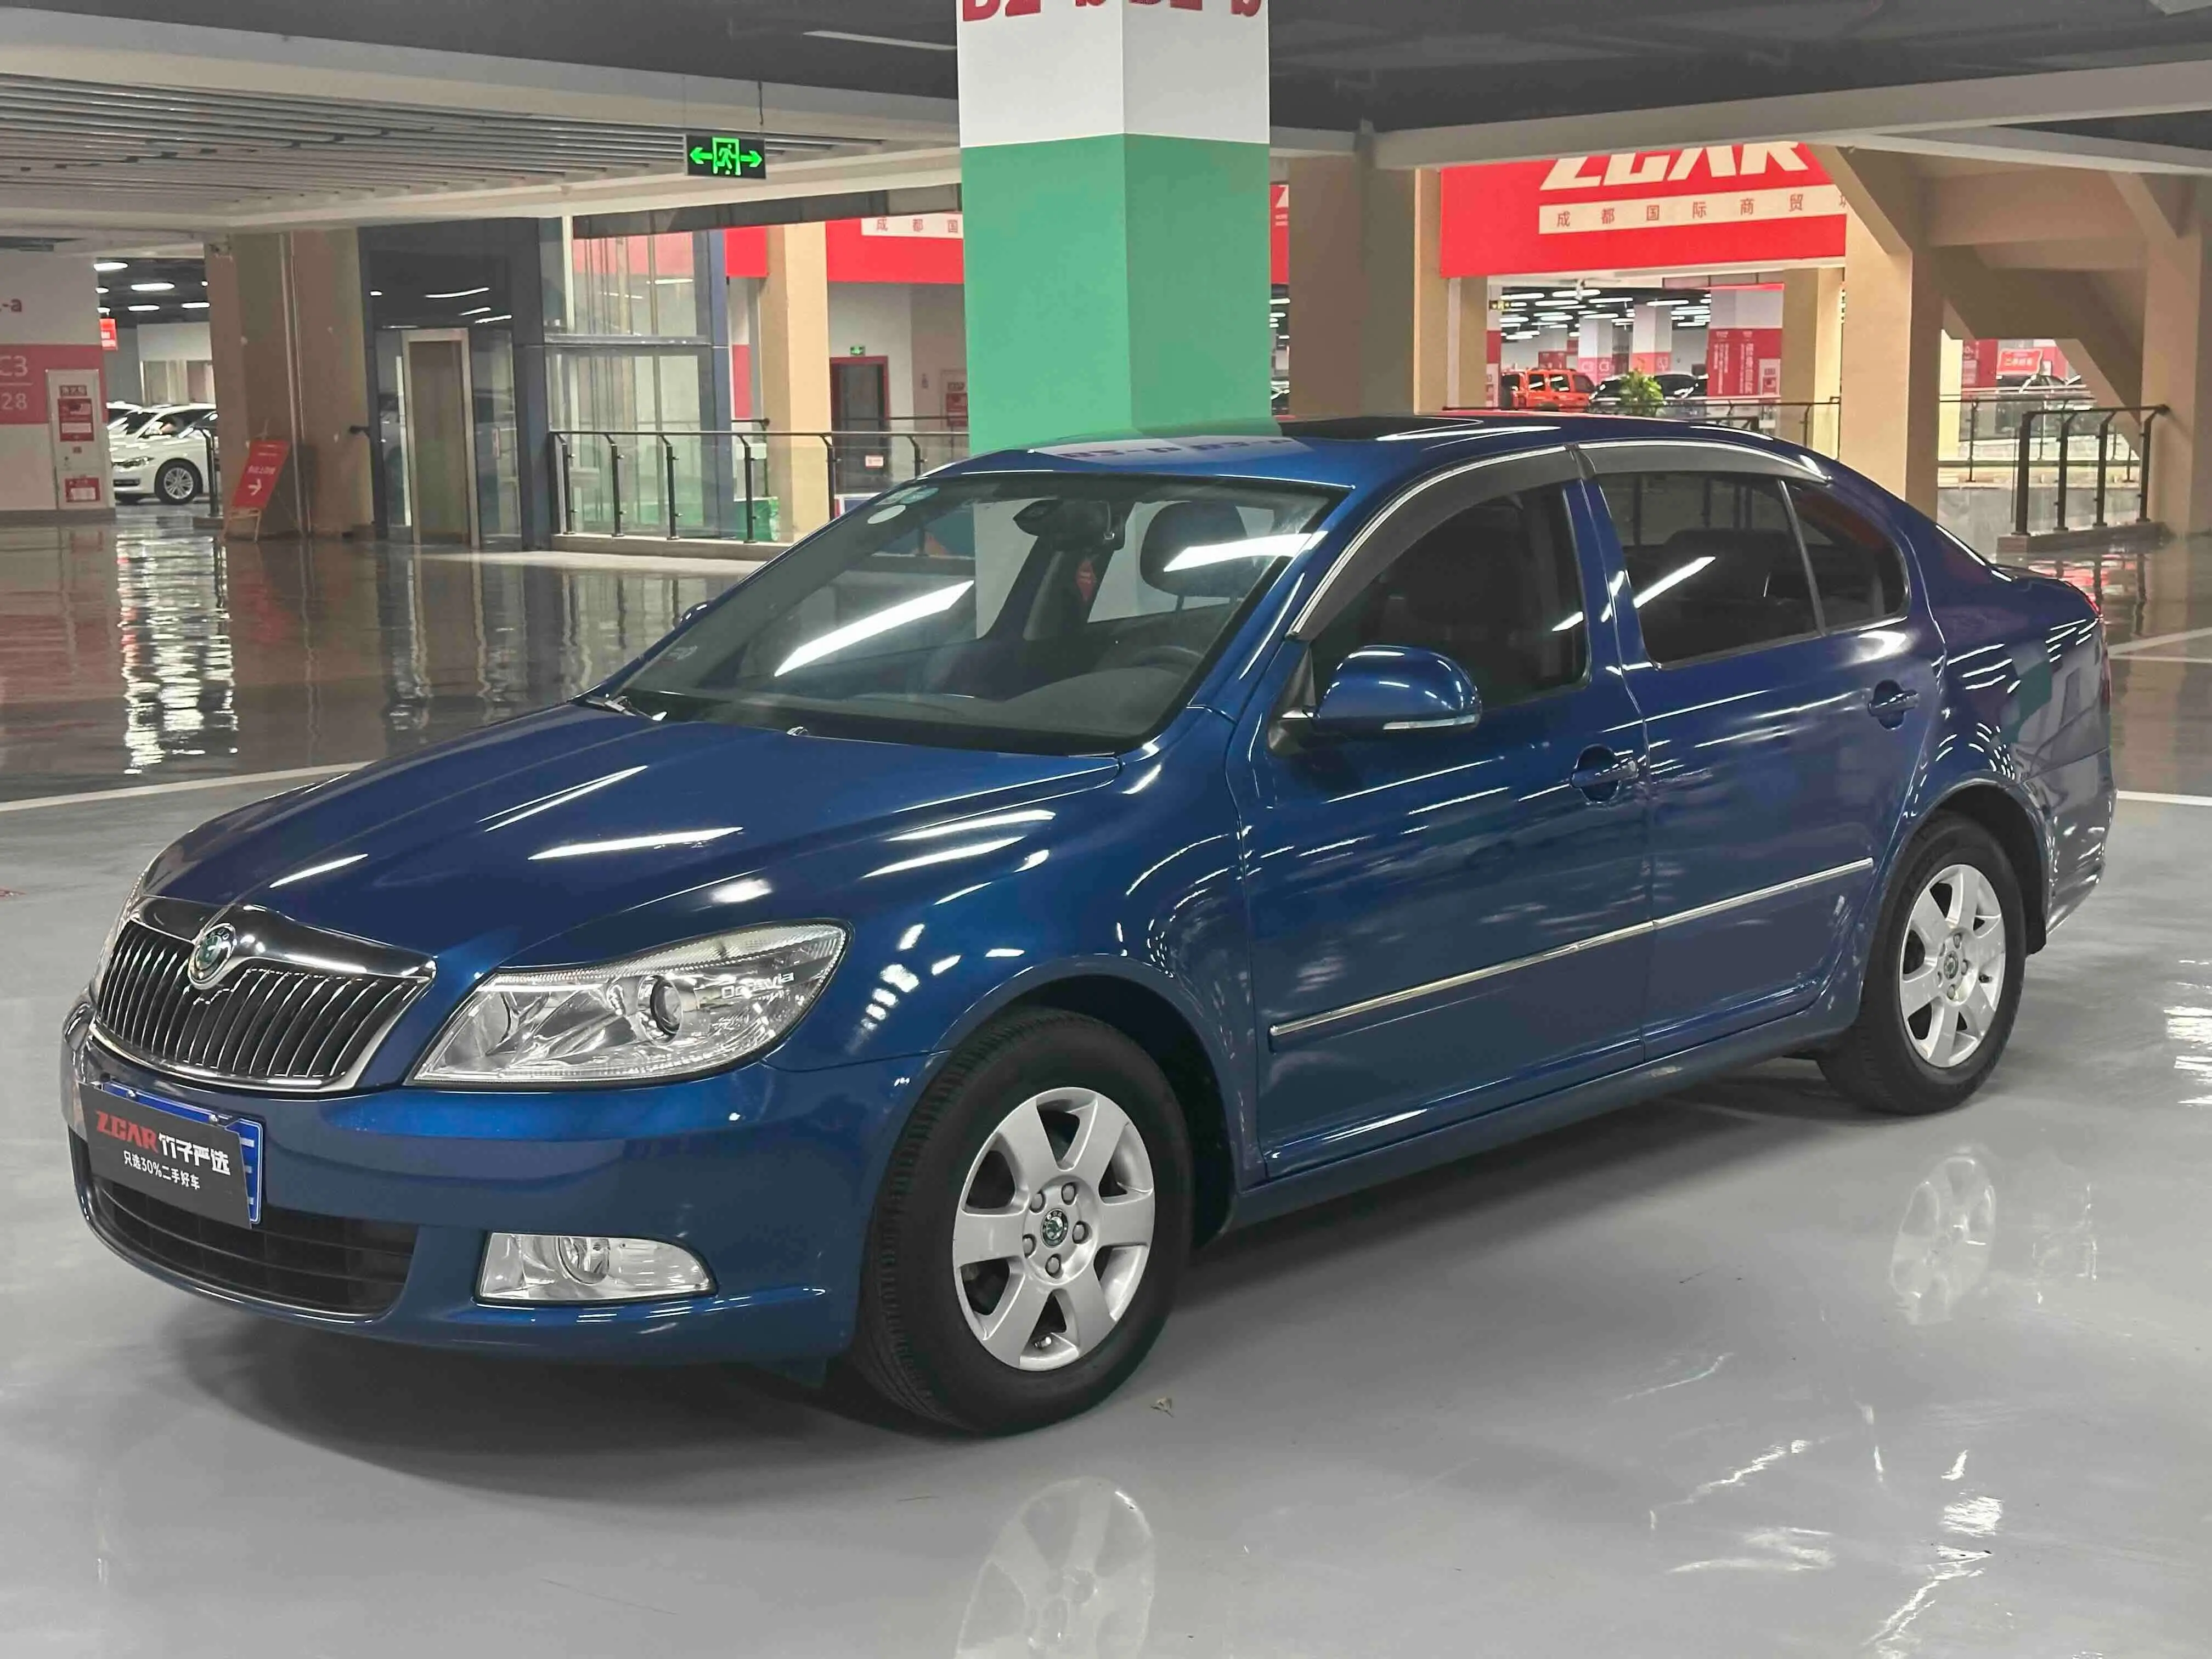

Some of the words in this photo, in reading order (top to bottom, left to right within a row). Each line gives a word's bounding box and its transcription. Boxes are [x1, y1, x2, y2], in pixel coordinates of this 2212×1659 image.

[95, 1110, 159, 1154] ZCAR
[158, 1132, 231, 1176] 竹子严选
[123, 1149, 201, 1190] 只选30%二手好车
